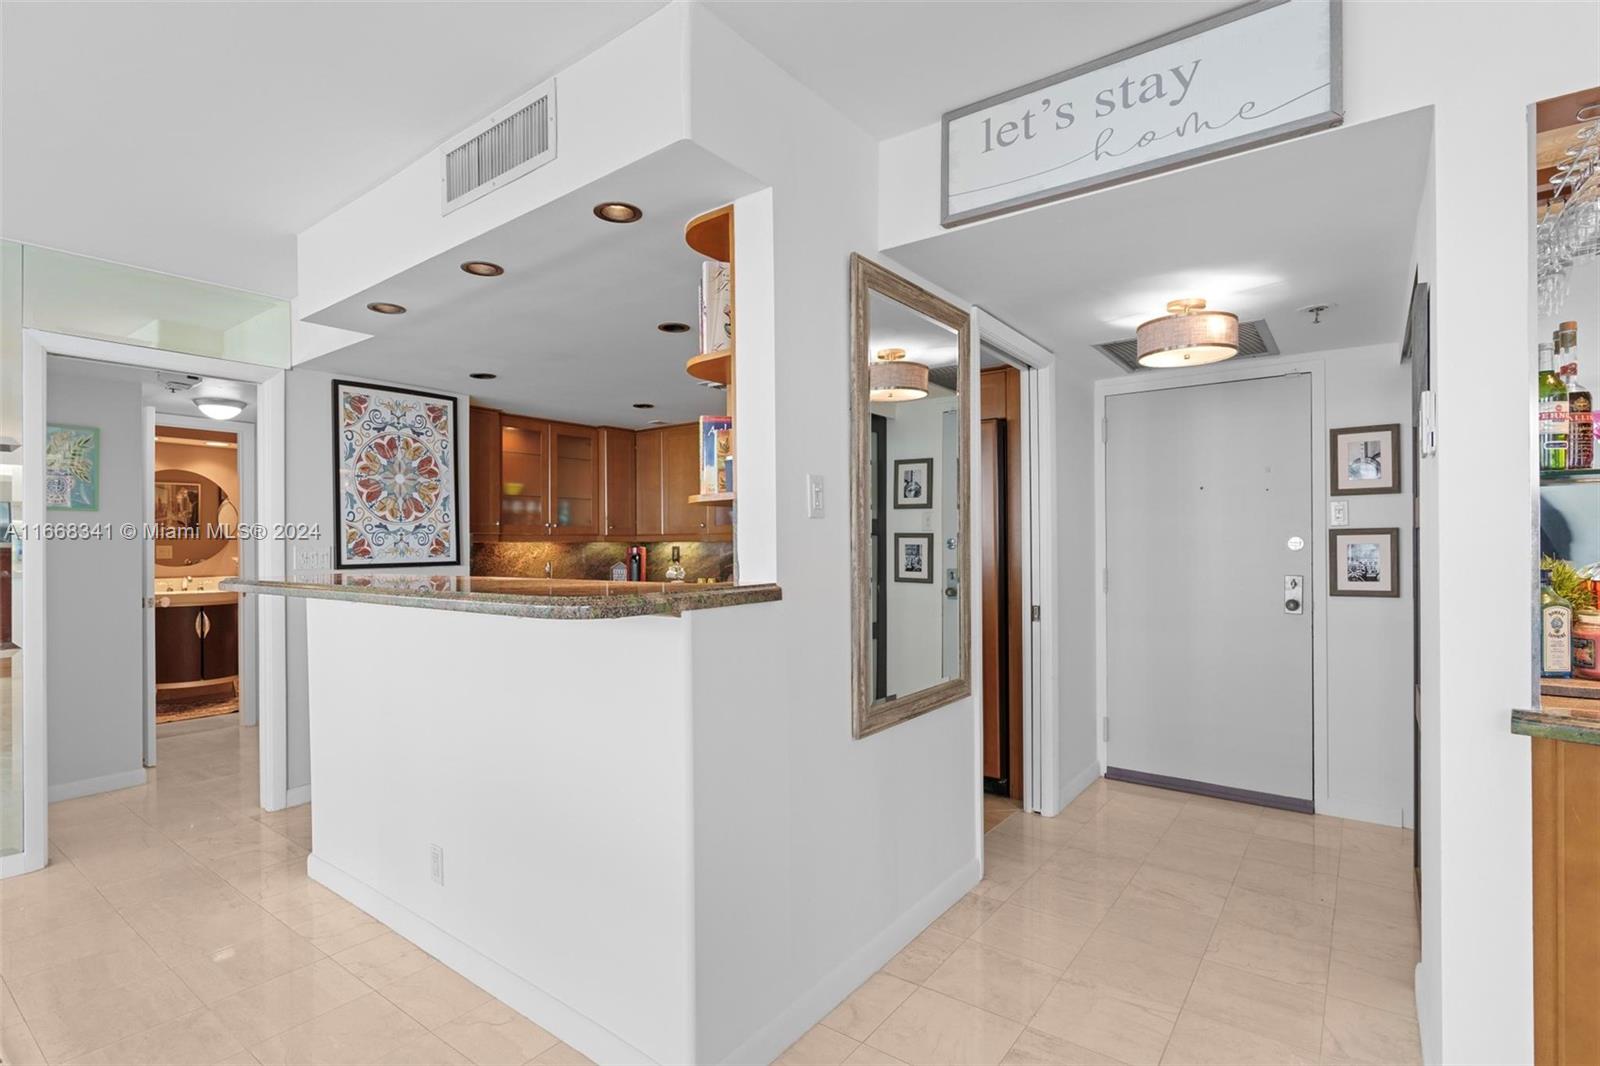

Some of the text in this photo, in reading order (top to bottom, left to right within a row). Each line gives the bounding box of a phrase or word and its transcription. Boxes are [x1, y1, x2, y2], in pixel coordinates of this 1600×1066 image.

[981, 58, 1202, 155] let’s stay
[1093, 100, 1259, 161] home
